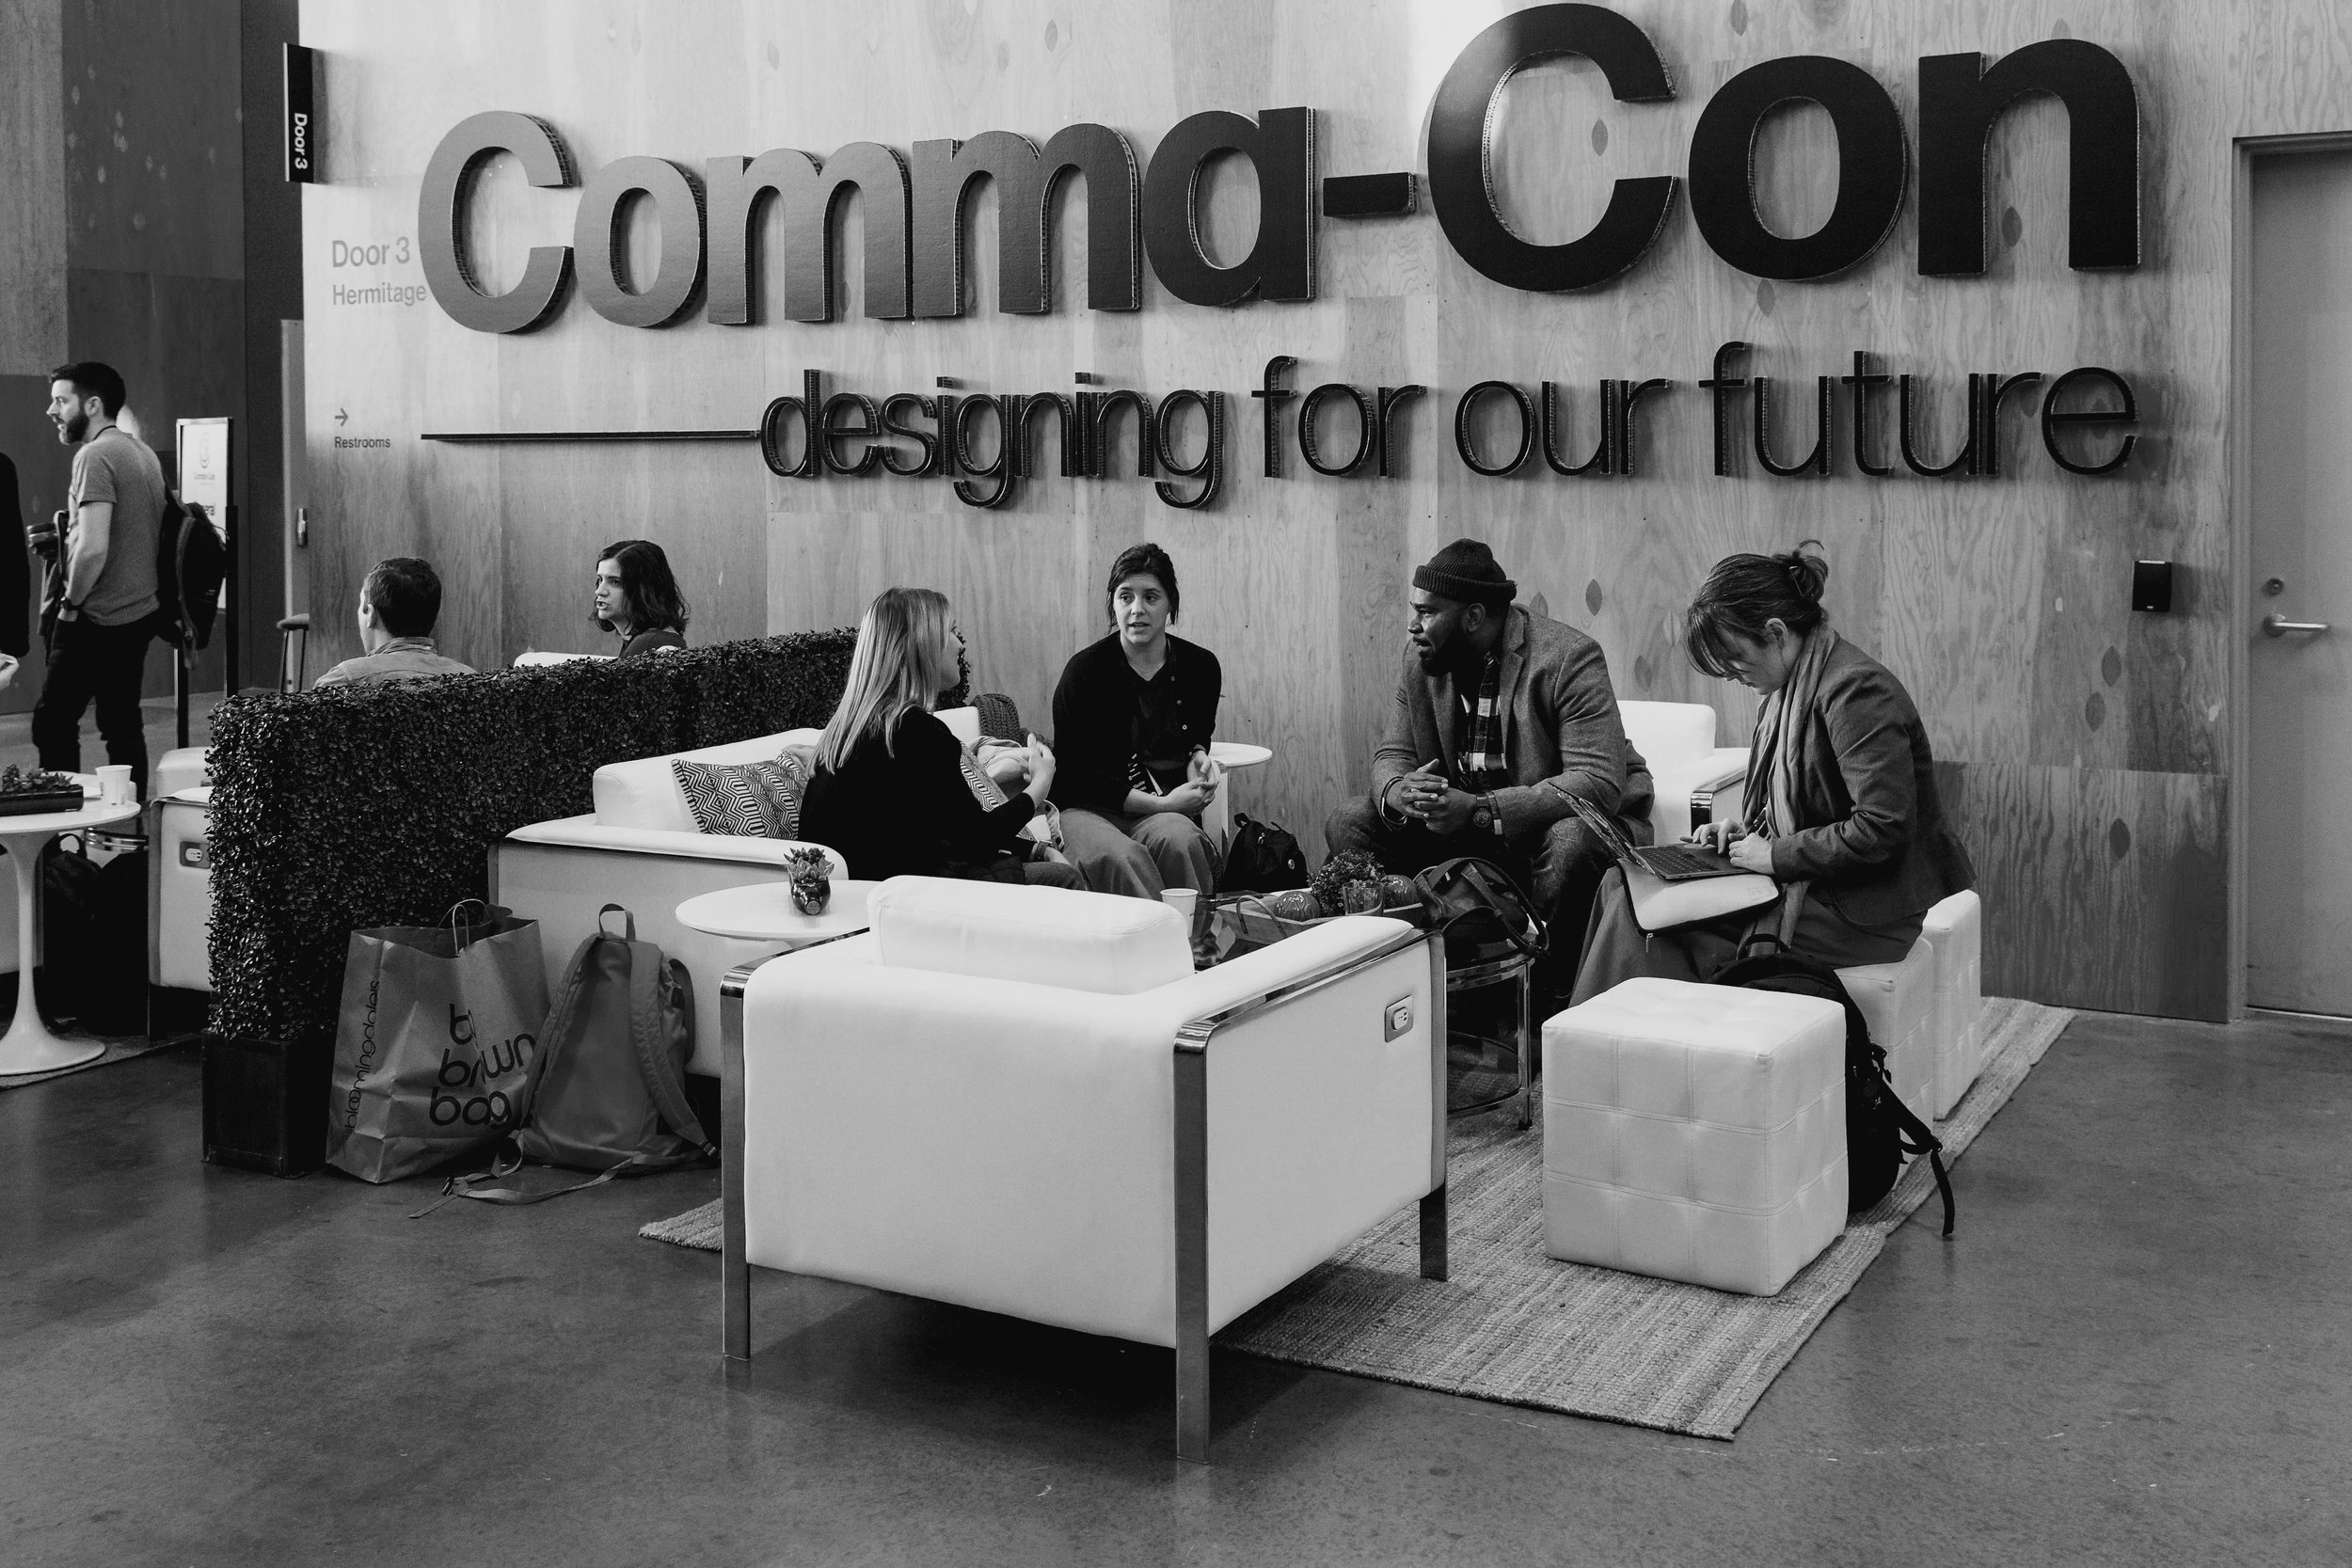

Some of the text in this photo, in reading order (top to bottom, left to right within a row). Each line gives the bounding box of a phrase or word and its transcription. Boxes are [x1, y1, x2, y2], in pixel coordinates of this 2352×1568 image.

[294, 113, 309, 169] Door 3
[418, 3, 2140, 333] Comma-Con
[331, 236, 411, 269] Door 3
[332, 282, 427, 307] Hermitage
[334, 436, 391, 449] Restrooms
[760, 341, 2139, 509] designing for our future
